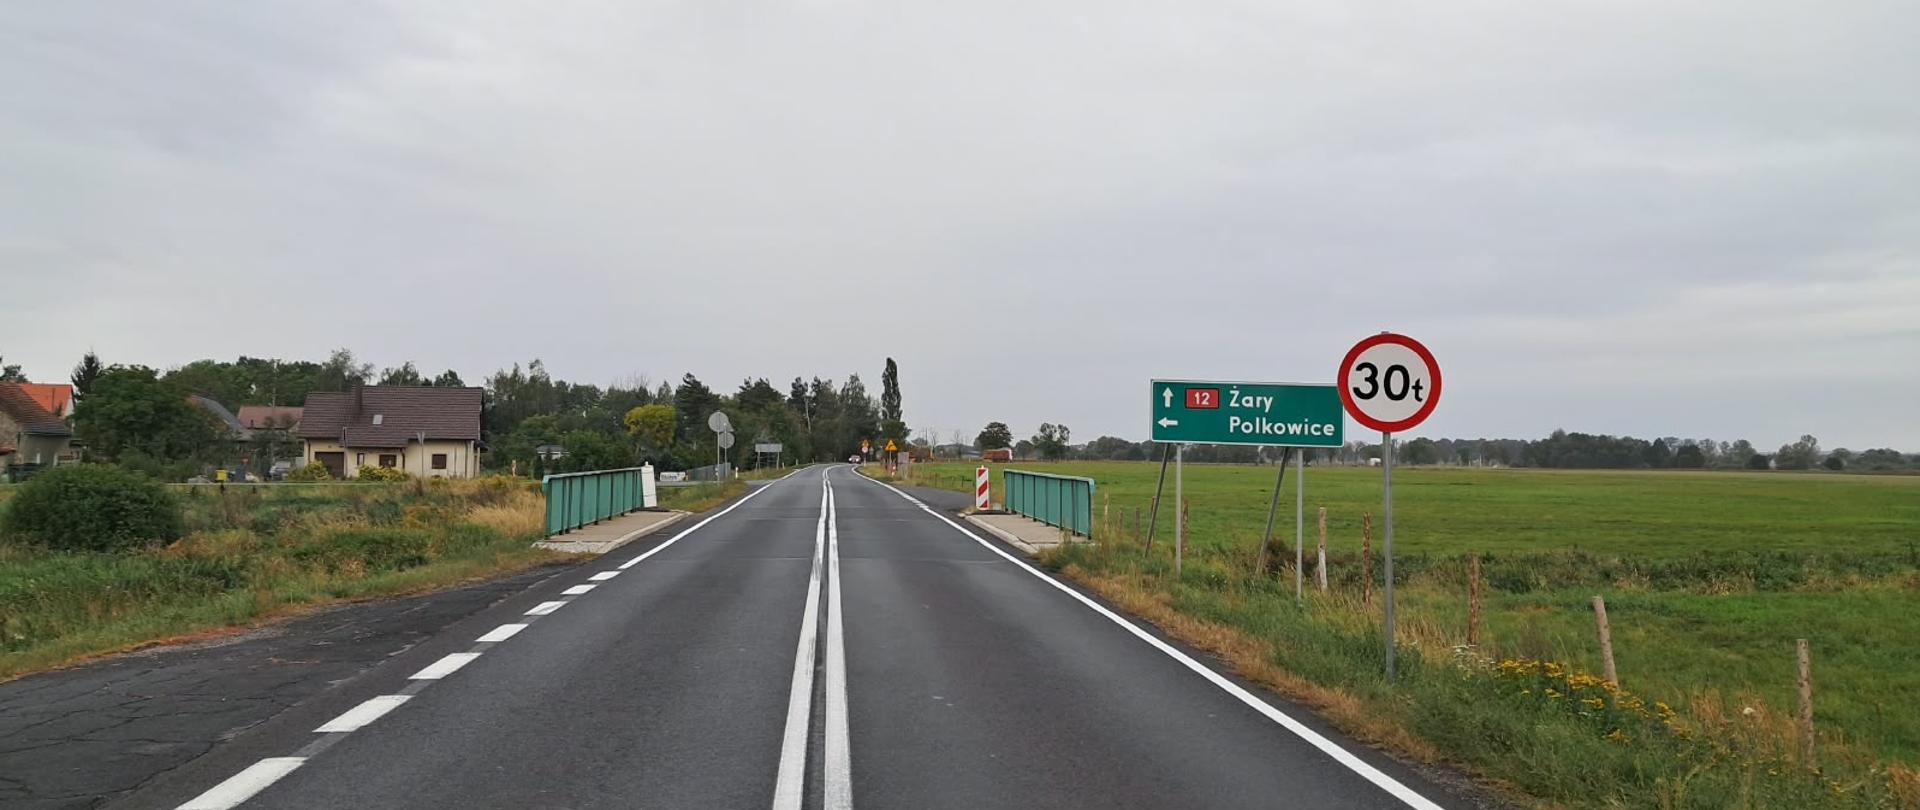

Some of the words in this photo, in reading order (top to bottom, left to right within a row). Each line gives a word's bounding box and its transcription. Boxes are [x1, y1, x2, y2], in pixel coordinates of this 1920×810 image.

[1353, 362, 1423, 402] 30t
[1194, 392, 1210, 406] 12
[1229, 386, 1273, 412] Żary
[1229, 416, 1335, 436] Polkowice
